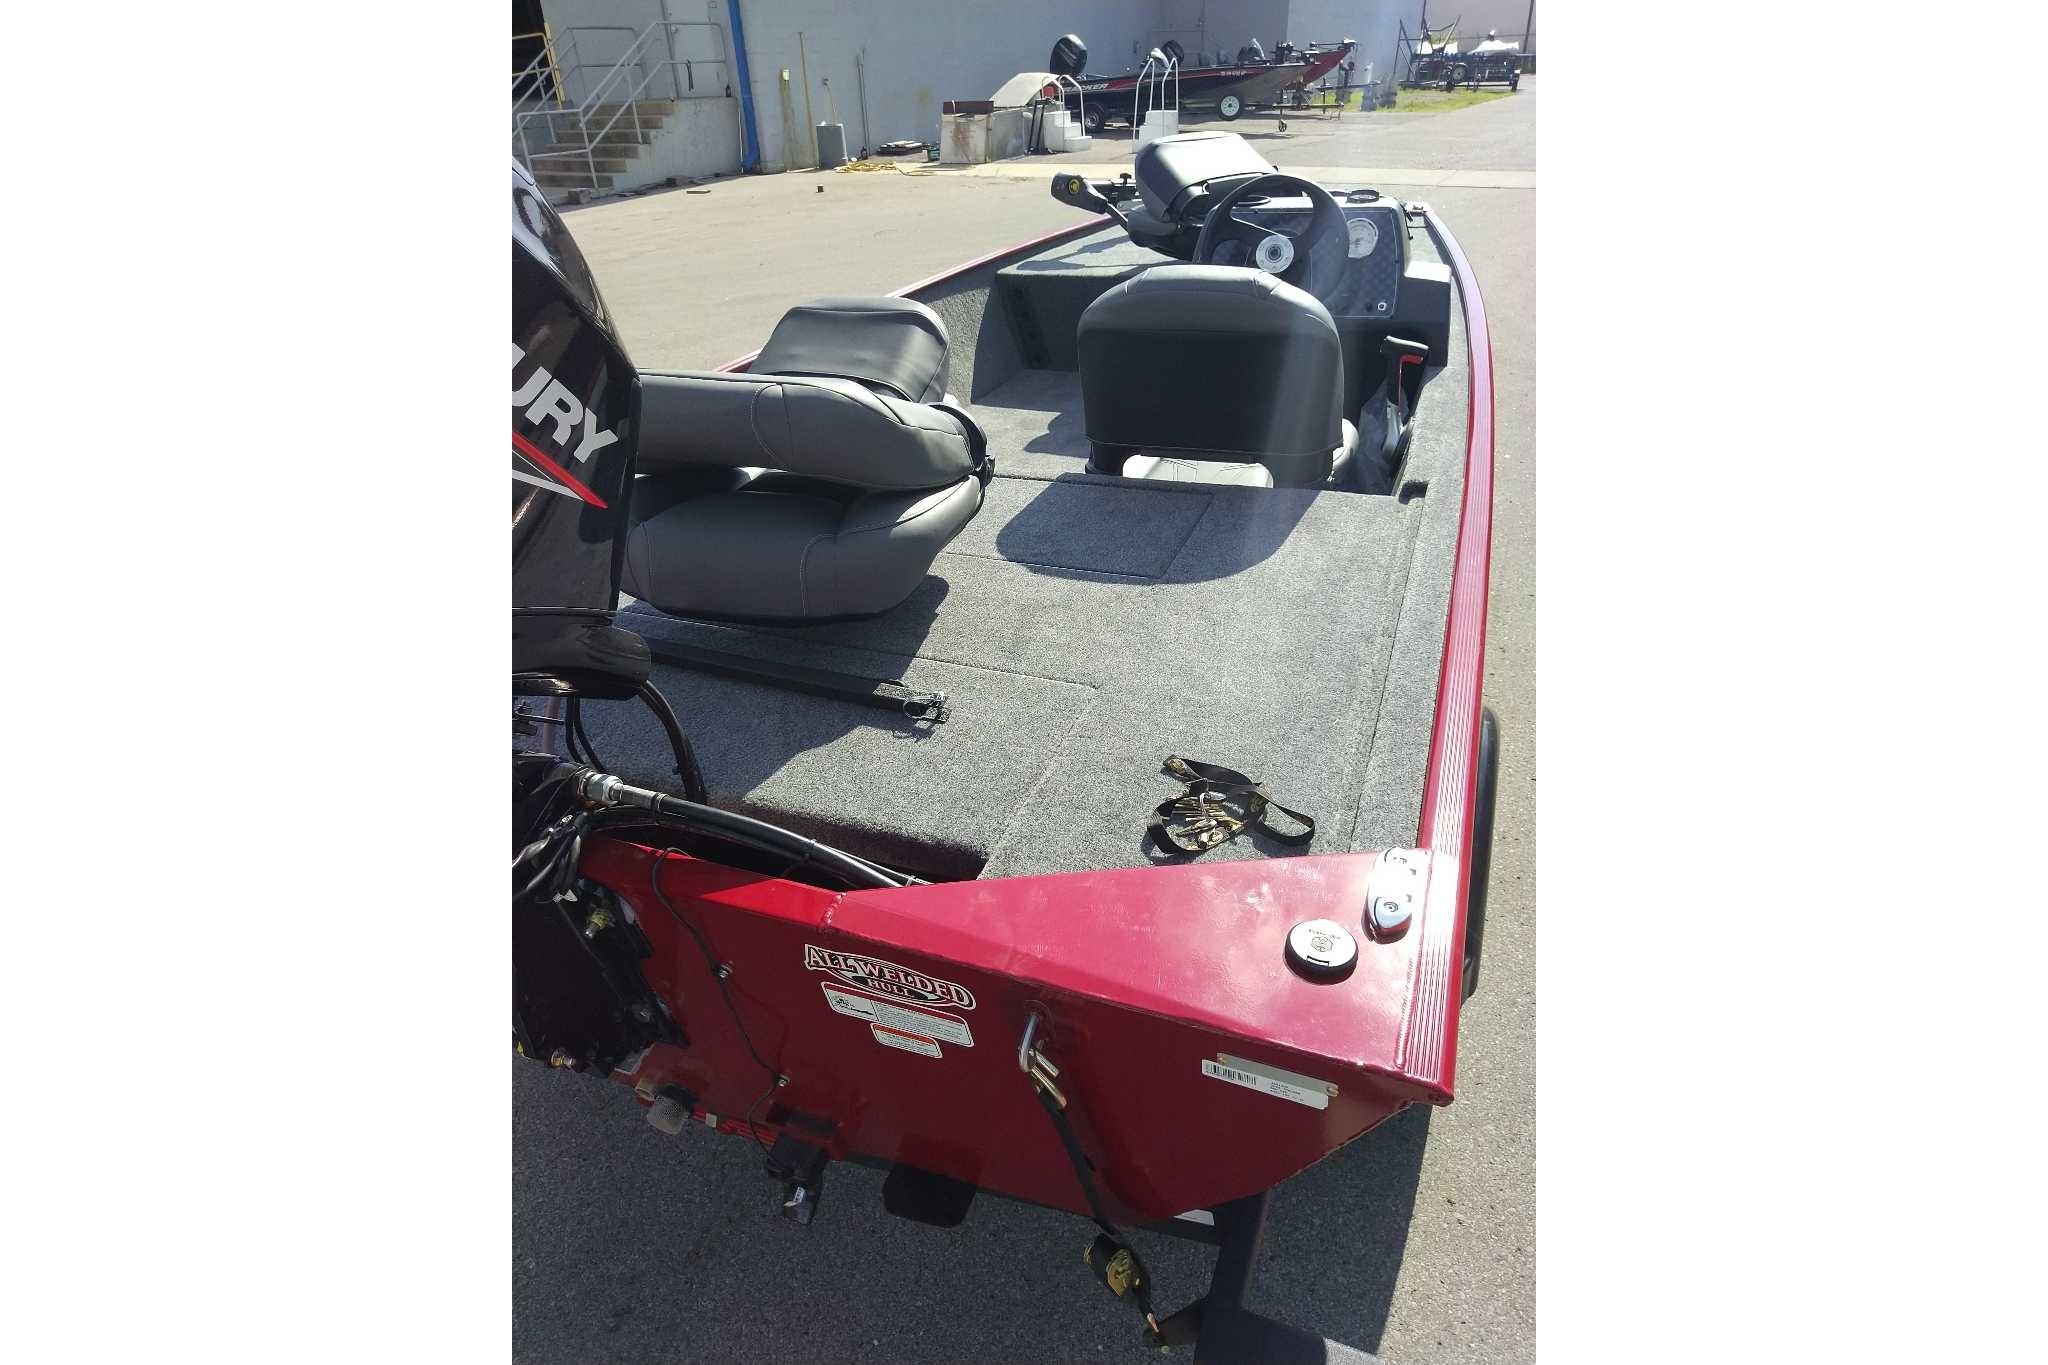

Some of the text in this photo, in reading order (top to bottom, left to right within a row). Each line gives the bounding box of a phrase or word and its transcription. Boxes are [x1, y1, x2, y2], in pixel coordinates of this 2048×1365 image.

[809, 948, 970, 1006] ALL WELDED
[867, 978, 916, 998] HULL
